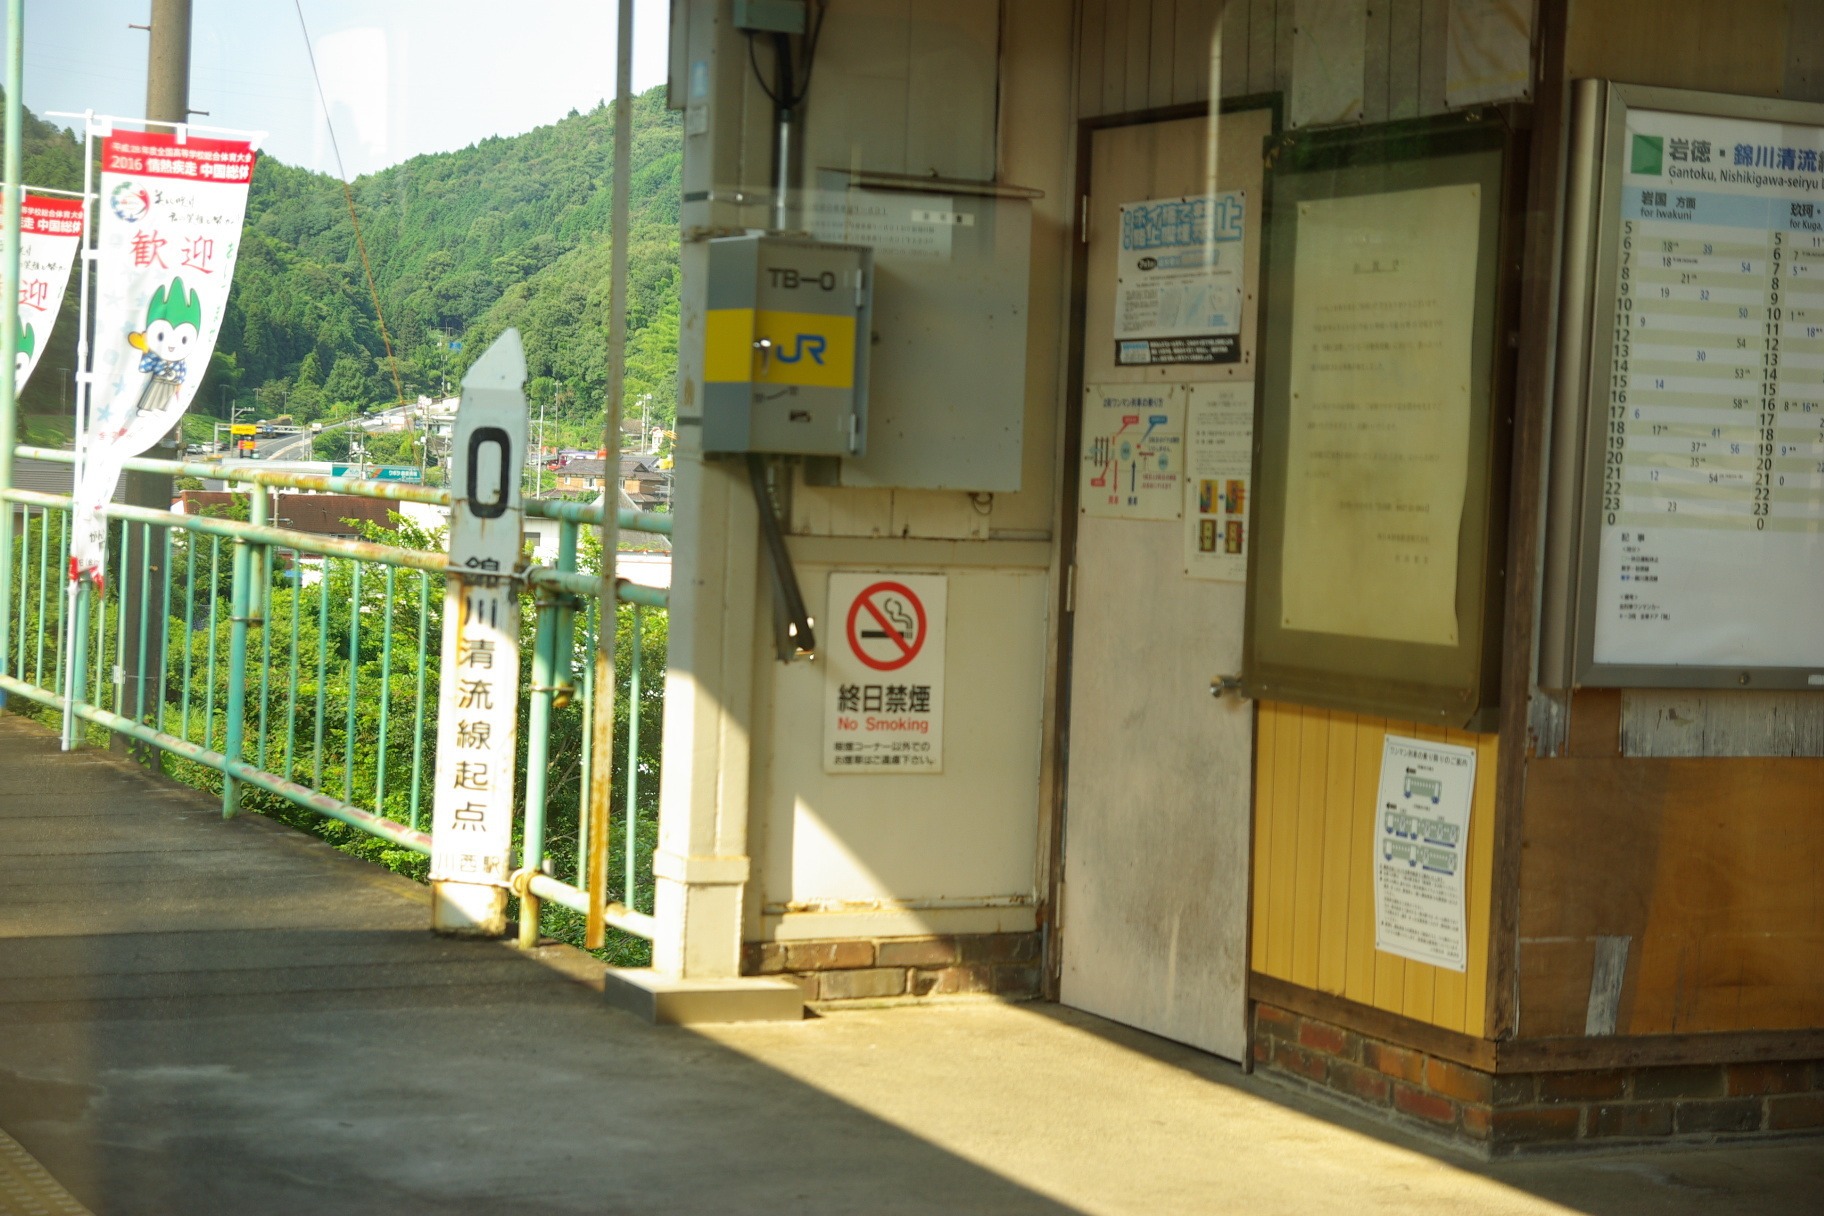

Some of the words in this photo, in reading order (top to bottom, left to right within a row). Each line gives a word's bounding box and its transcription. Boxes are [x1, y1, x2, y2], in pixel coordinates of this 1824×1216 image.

[111, 156, 142, 170] 2016
[146, 158, 198, 176] 情熱疾走
[200, 164, 250, 180] 中国総体
[1668, 166, 1716, 182] Gantoku,
[1720, 170, 1818, 191] Nishikigawa-seiryu
[1642, 190, 1666, 207] 岩国
[1676, 196, 1696, 210] 方面
[1640, 206, 1652, 217] for
[1656, 208, 1692, 220] Iwakuni
[1625, 222, 1632, 234] 5
[1790, 218, 1800, 230] for
[1802, 220, 1823, 232] Kuga,
[1774, 232, 1781, 245] 5
[129, 228, 214, 274] 歓迎
[1624, 237, 1631, 249] 6
[1703, 244, 1712, 255] 39
[1773, 248, 1780, 260] 6
[1623, 252, 1630, 264] 7
[1742, 262, 1750, 272] 54
[1773, 262, 1780, 275] 7
[1622, 267, 1629, 279] 8
[1772, 278, 1779, 290] 8
[18, 278, 48, 312] 迎
[1621, 283, 1629, 295] 9
[1661, 287, 1670, 298] 19
[1700, 290, 1709, 300] 32
[1770, 293, 1778, 305] 9
[1617, 299, 1632, 310] 10
[1739, 308, 1748, 318] 50
[1767, 308, 1781, 320] 10
[1616, 314, 1630, 326] 11
[1641, 317, 1646, 327] 9
[1766, 323, 1778, 336] 11
[1615, 330, 1630, 342] 12
[1737, 338, 1746, 348] 54
[1765, 338, 1778, 350] 12
[776, 334, 826, 365] JR
[1614, 345, 1629, 357] 13
[1696, 351, 1706, 361] 30
[1614, 360, 1628, 372] 14
[1764, 354, 1778, 366] 13
[1763, 368, 1777, 380] 14
[1612, 376, 1627, 387] 15
[1656, 379, 1664, 389] 14
[1762, 384, 1776, 395] 15
[1612, 391, 1626, 403] 16
[1761, 398, 1775, 410] 16
[1611, 406, 1625, 418] 17
[1635, 409, 1640, 419] 6
[1760, 414, 1774, 426] 17
[1610, 422, 1624, 434] 18
[1712, 428, 1720, 438] 41
[1760, 429, 1774, 441] 18
[1609, 437, 1624, 449] 19
[1731, 444, 1739, 454] 56
[1759, 443, 1773, 456] 19
[1607, 452, 1623, 464] 20
[1757, 458, 1772, 470] 20
[466, 426, 512, 518] 0
[1606, 468, 1621, 479] 21
[1650, 471, 1659, 481] 12
[1756, 473, 1770, 486] 21
[1780, 476, 1784, 486] 0
[1606, 482, 1621, 495] 22
[1755, 488, 1770, 500] 22
[1605, 498, 1620, 510] 23
[1668, 502, 1677, 512] 23
[1754, 503, 1768, 516] 23
[1608, 514, 1616, 525] 0
[1757, 518, 1764, 530] 0
[452, 554, 501, 832] 錦川清流線起点
[837, 684, 931, 713] 終日禁煙
[838, 716, 858, 731] No
[866, 716, 929, 733] Smoking
